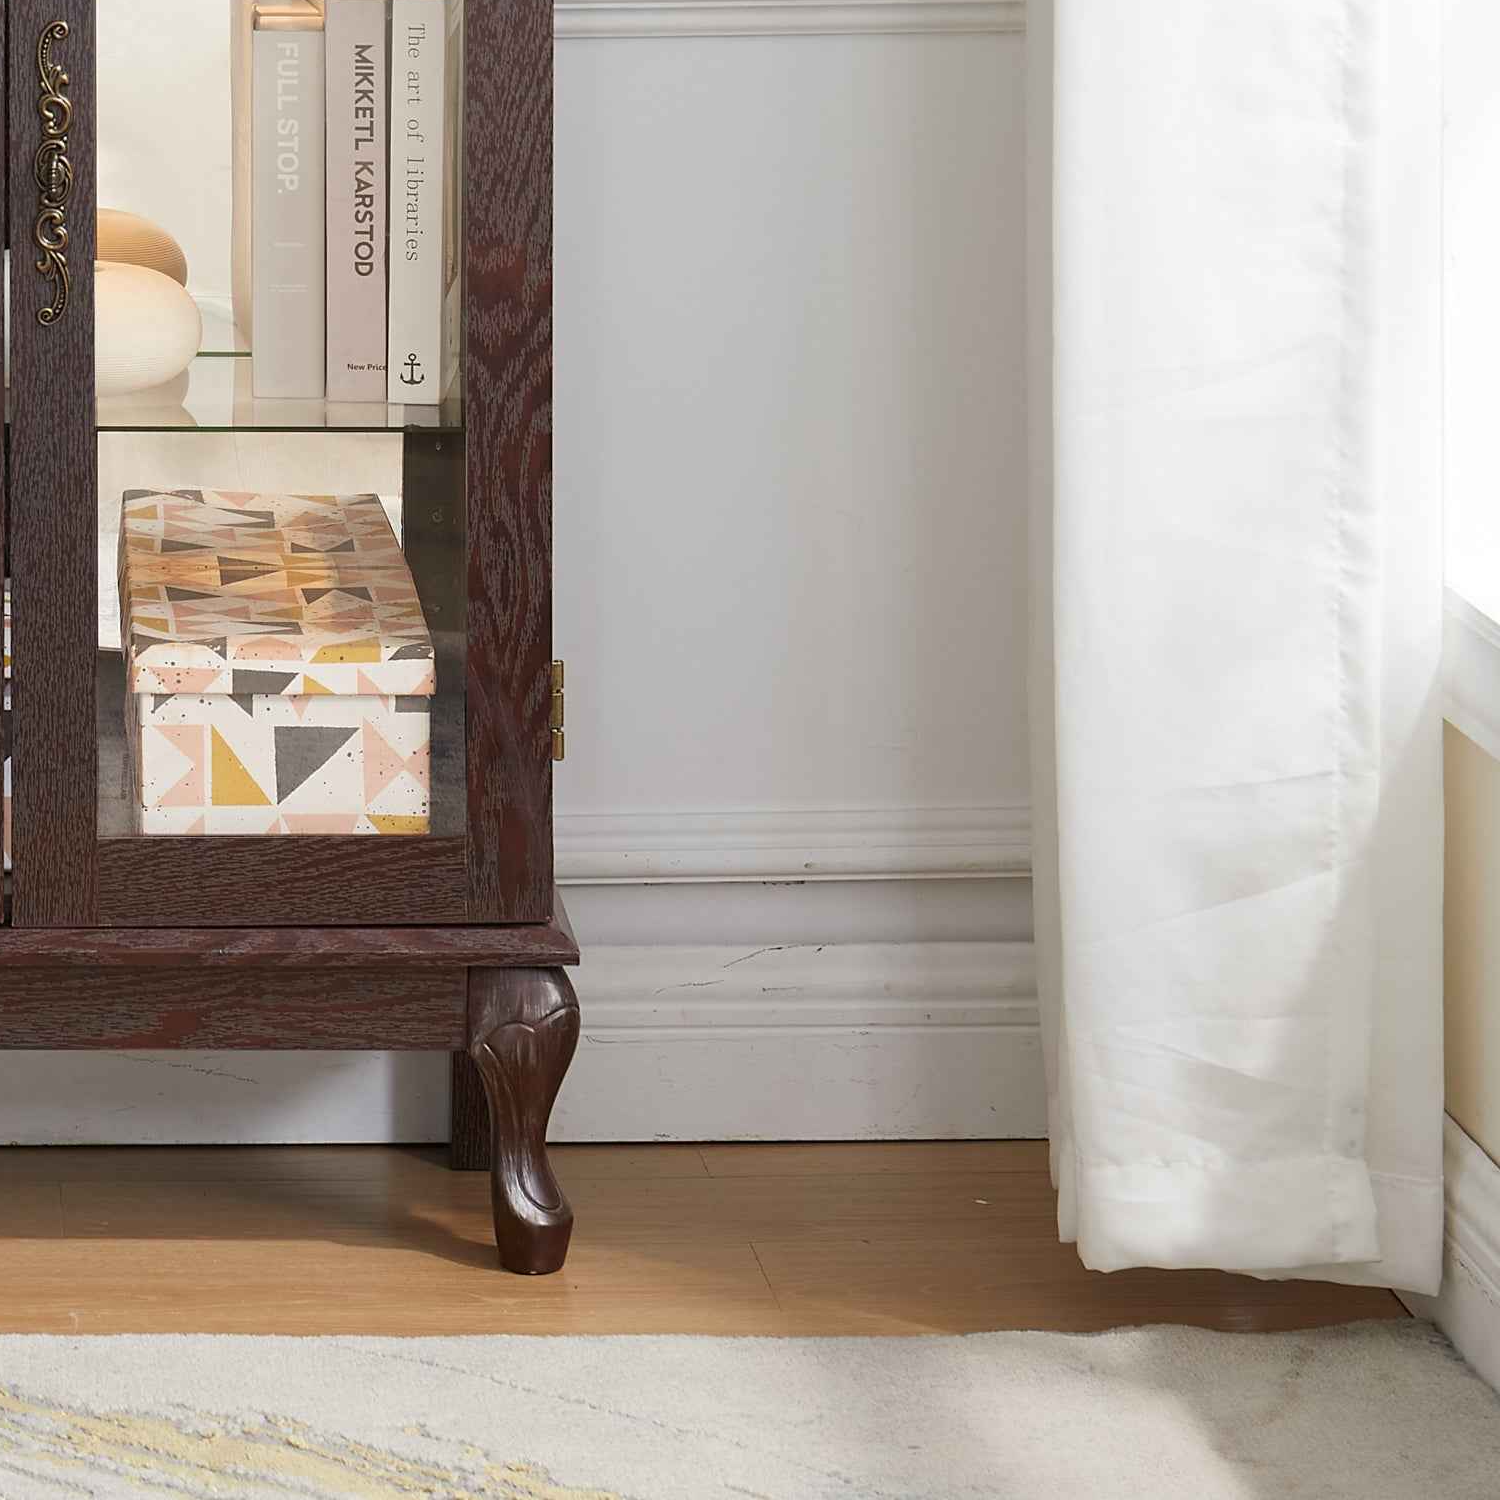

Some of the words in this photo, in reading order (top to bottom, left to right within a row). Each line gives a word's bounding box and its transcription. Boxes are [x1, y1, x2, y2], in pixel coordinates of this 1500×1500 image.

[276, 41, 300, 111] FULL
[406, 22, 426, 60] The
[354, 43, 374, 151] MIKKETL
[406, 71, 424, 105] art
[276, 117, 300, 195] STOP.
[406, 119, 425, 143] of
[354, 160, 374, 277] KARSTOD
[405, 155, 425, 262] libraries
[347, 363, 366, 371] New
